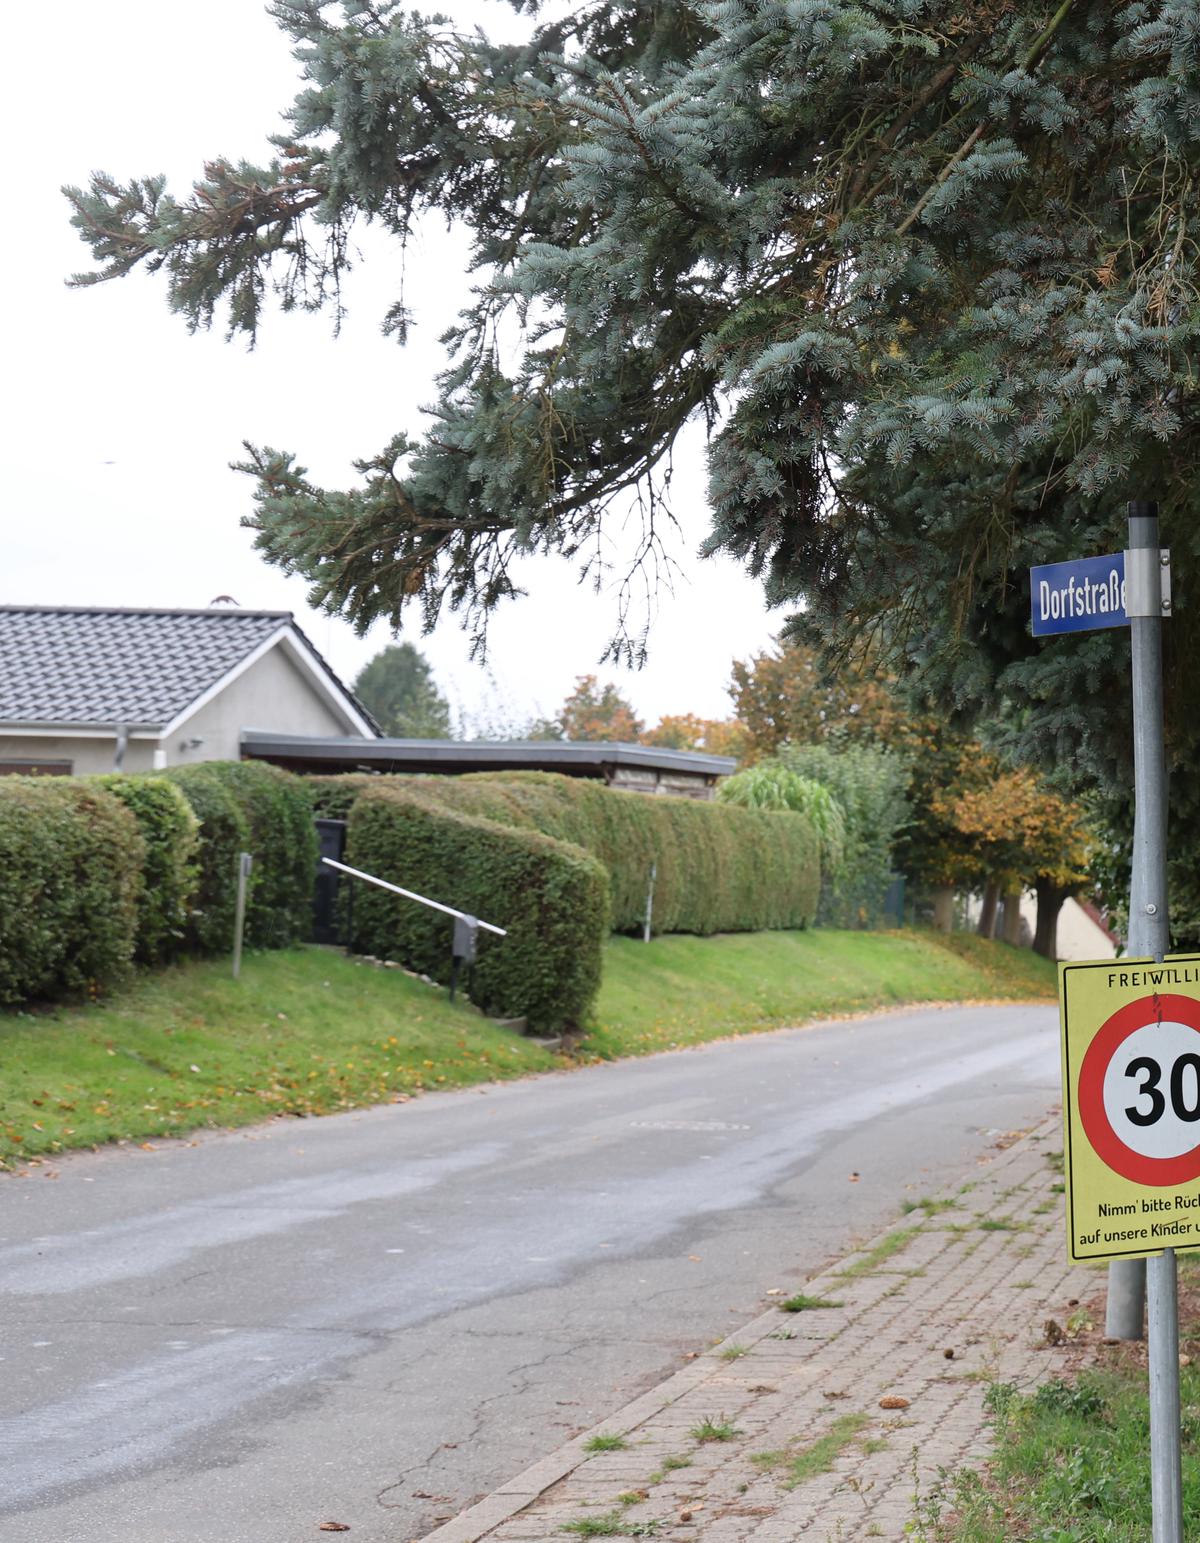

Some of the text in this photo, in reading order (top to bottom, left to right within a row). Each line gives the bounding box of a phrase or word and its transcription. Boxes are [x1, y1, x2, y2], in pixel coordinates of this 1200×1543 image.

[1098, 1200, 1139, 1218] Nimm'
[1142, 1197, 1172, 1213] bitte
[1079, 1227, 1101, 1246] auf
[1104, 1224, 1148, 1242] unsere
[1151, 1218, 1193, 1237] Kinder
